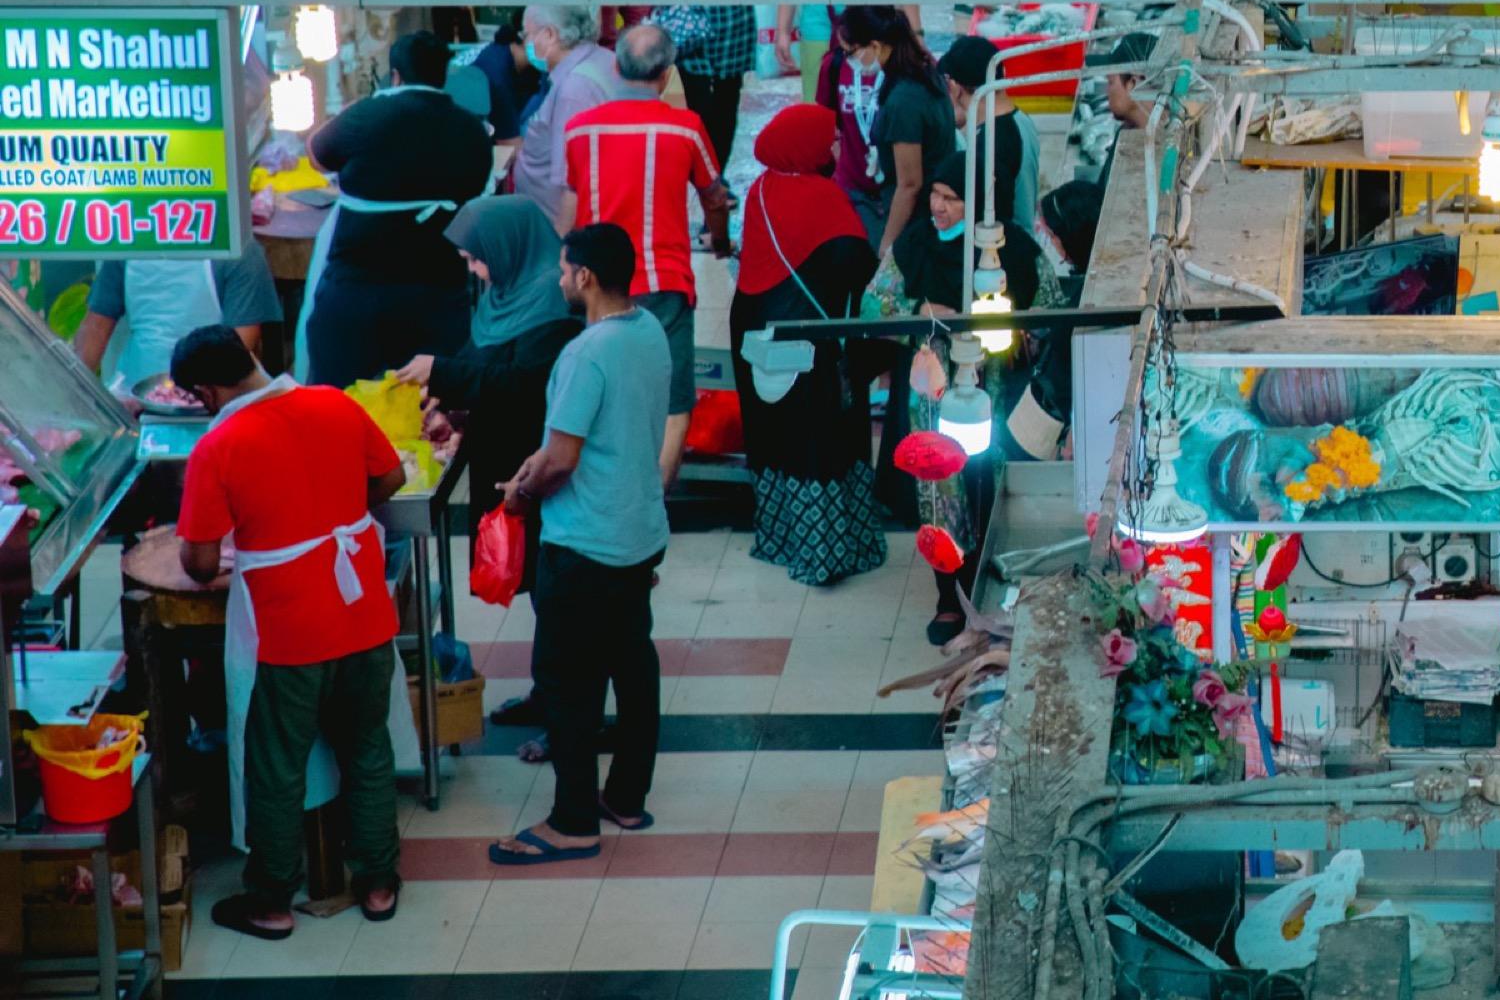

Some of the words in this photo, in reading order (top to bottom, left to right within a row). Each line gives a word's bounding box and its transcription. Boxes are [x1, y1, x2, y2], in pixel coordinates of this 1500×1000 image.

[5, 28, 39, 69] M
[46, 28, 71, 69] N
[78, 28, 210, 69] Shahul
[0, 78, 42, 119] ed
[49, 78, 212, 122] Marketing
[51, 135, 168, 165] QUALITY
[143, 169, 212, 186] MUTTON
[84, 200, 216, 243] 01-127
